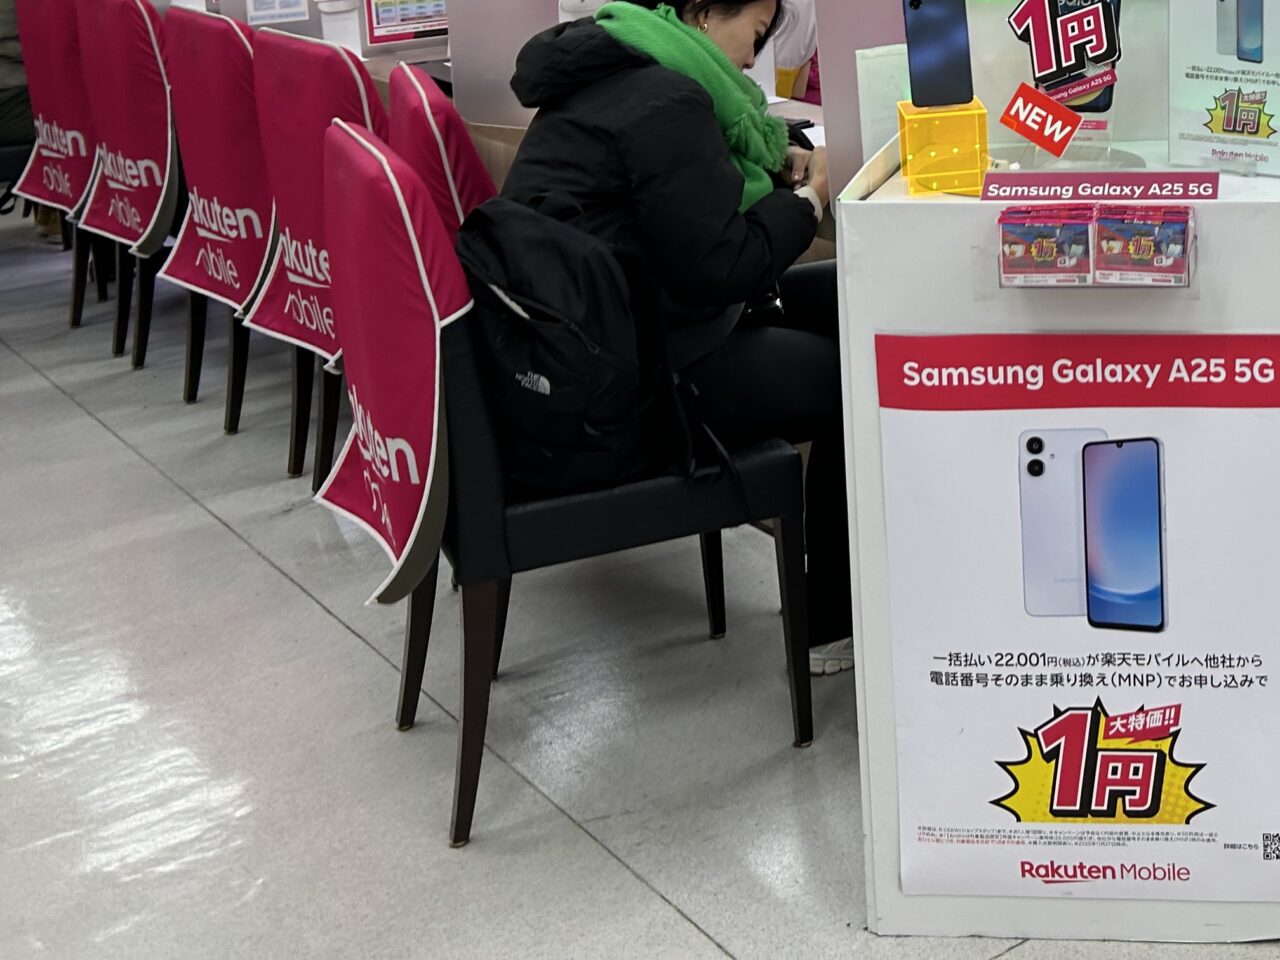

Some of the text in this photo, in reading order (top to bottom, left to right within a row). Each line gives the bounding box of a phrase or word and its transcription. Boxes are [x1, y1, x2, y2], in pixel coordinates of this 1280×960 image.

[1068, 74, 1112, 96] Galaxy A25 5G
[1009, 96, 1072, 143] NEW
[1220, 90, 1260, 133] 1円
[1211, 148, 1269, 162] Rakuten Mobile
[987, 181, 1213, 200] Samsung Galaxy A25 5G
[903, 358, 1275, 390] Samsung Galaxy A25 5G
[932, 651, 1263, 669] 一括払い22,001円(税込)が楽天モバイルへ他社から
[929, 671, 1269, 689] 電話番号そのまま乗り換え(MNP)でお申し込みで
[1108, 708, 1176, 735] 大特価!!
[1038, 708, 1155, 811] 1円
[1223, 843, 1259, 851] 詳細はこちら
[1020, 860, 1191, 884] Rakuten Mobile
